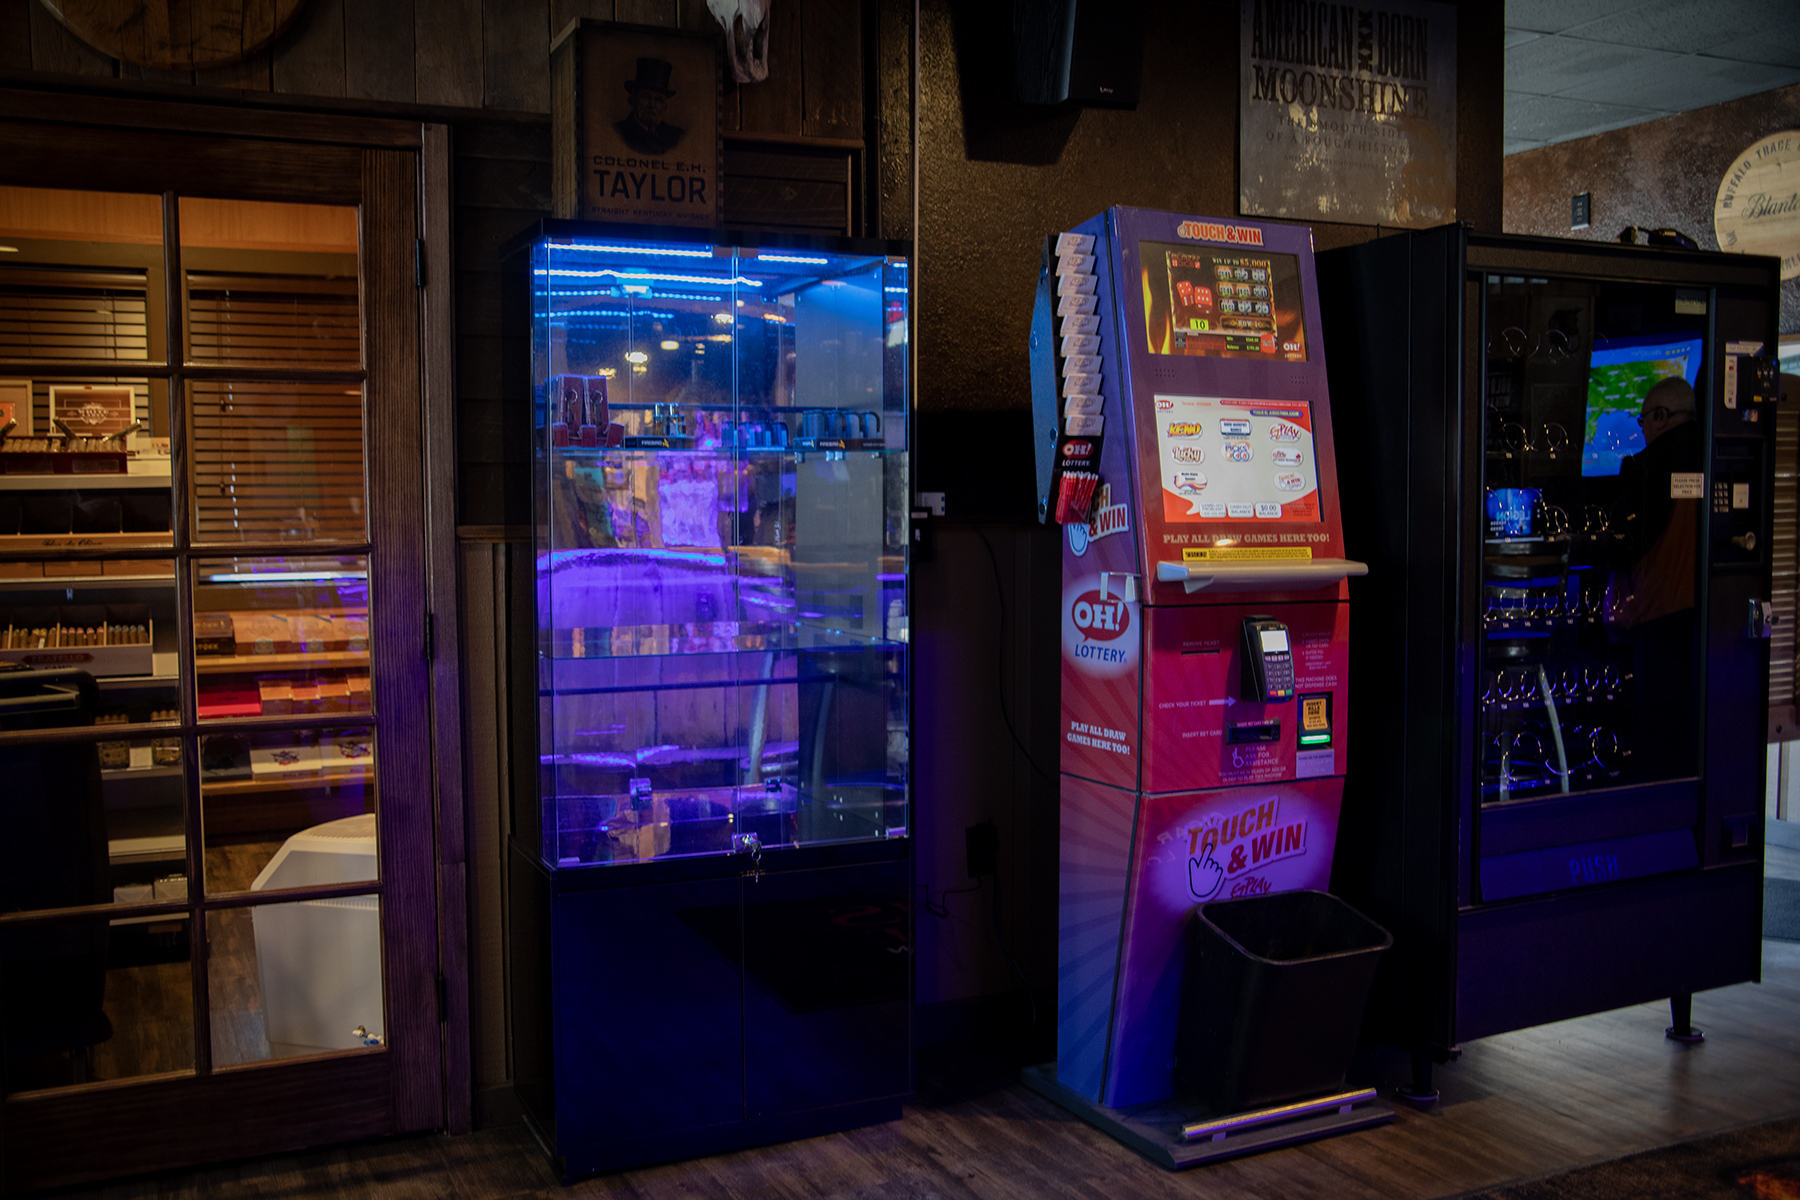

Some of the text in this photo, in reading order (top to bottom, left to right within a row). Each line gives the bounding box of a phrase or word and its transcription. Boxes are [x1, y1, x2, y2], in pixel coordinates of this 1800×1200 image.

[1251, 0, 1428, 81] AMERICAN BORN
[1252, 64, 1428, 119] MOONSHINE
[1279, 115, 1304, 129] THE
[1311, 118, 1367, 136] SMOOTH
[1265, 131, 1283, 142] OF
[1290, 133, 1298, 145] A
[1305, 134, 1351, 150] ROUGH
[593, 155, 707, 173] COLONEL E.H.
[1723, 138, 1792, 209] BUFFALO TRACE
[593, 169, 707, 204] TAYLOR
[591, 206, 710, 221] STRAIGHT KENTUCKY WHISKEY
[1184, 222, 1262, 244] TOUCH & WIN
[1195, 320, 1206, 330] 10
[1168, 423, 1202, 438] KENO
[1063, 442, 1093, 456] OH!
[1061, 459, 1091, 467] LOTTERY
[1088, 507, 1127, 537] & WIN
[1162, 534, 1190, 544] PLAY
[1191, 534, 1211, 543] ALL
[1244, 533, 1278, 543] GAMES
[1279, 533, 1306, 543] HERE
[1307, 533, 1331, 543] TOO!
[1073, 600, 1124, 632] OH!
[31, 653, 84, 664] FRATELLO
[1075, 644, 1126, 663] LOTTERY
[1071, 721, 1126, 742] PLAY ALL DRAW
[1182, 731, 1199, 739] INSERT
[1210, 729, 1223, 737] CARD
[1067, 732, 1130, 756] GAMES HERE TOO!
[1245, 758, 1279, 767] ASSISTANCE
[1258, 751, 1270, 759] FOR
[1188, 800, 1275, 855] TOUCH
[1227, 844, 1248, 874] &
[1251, 823, 1303, 864] WIN
[1569, 853, 1619, 883] PUSH
